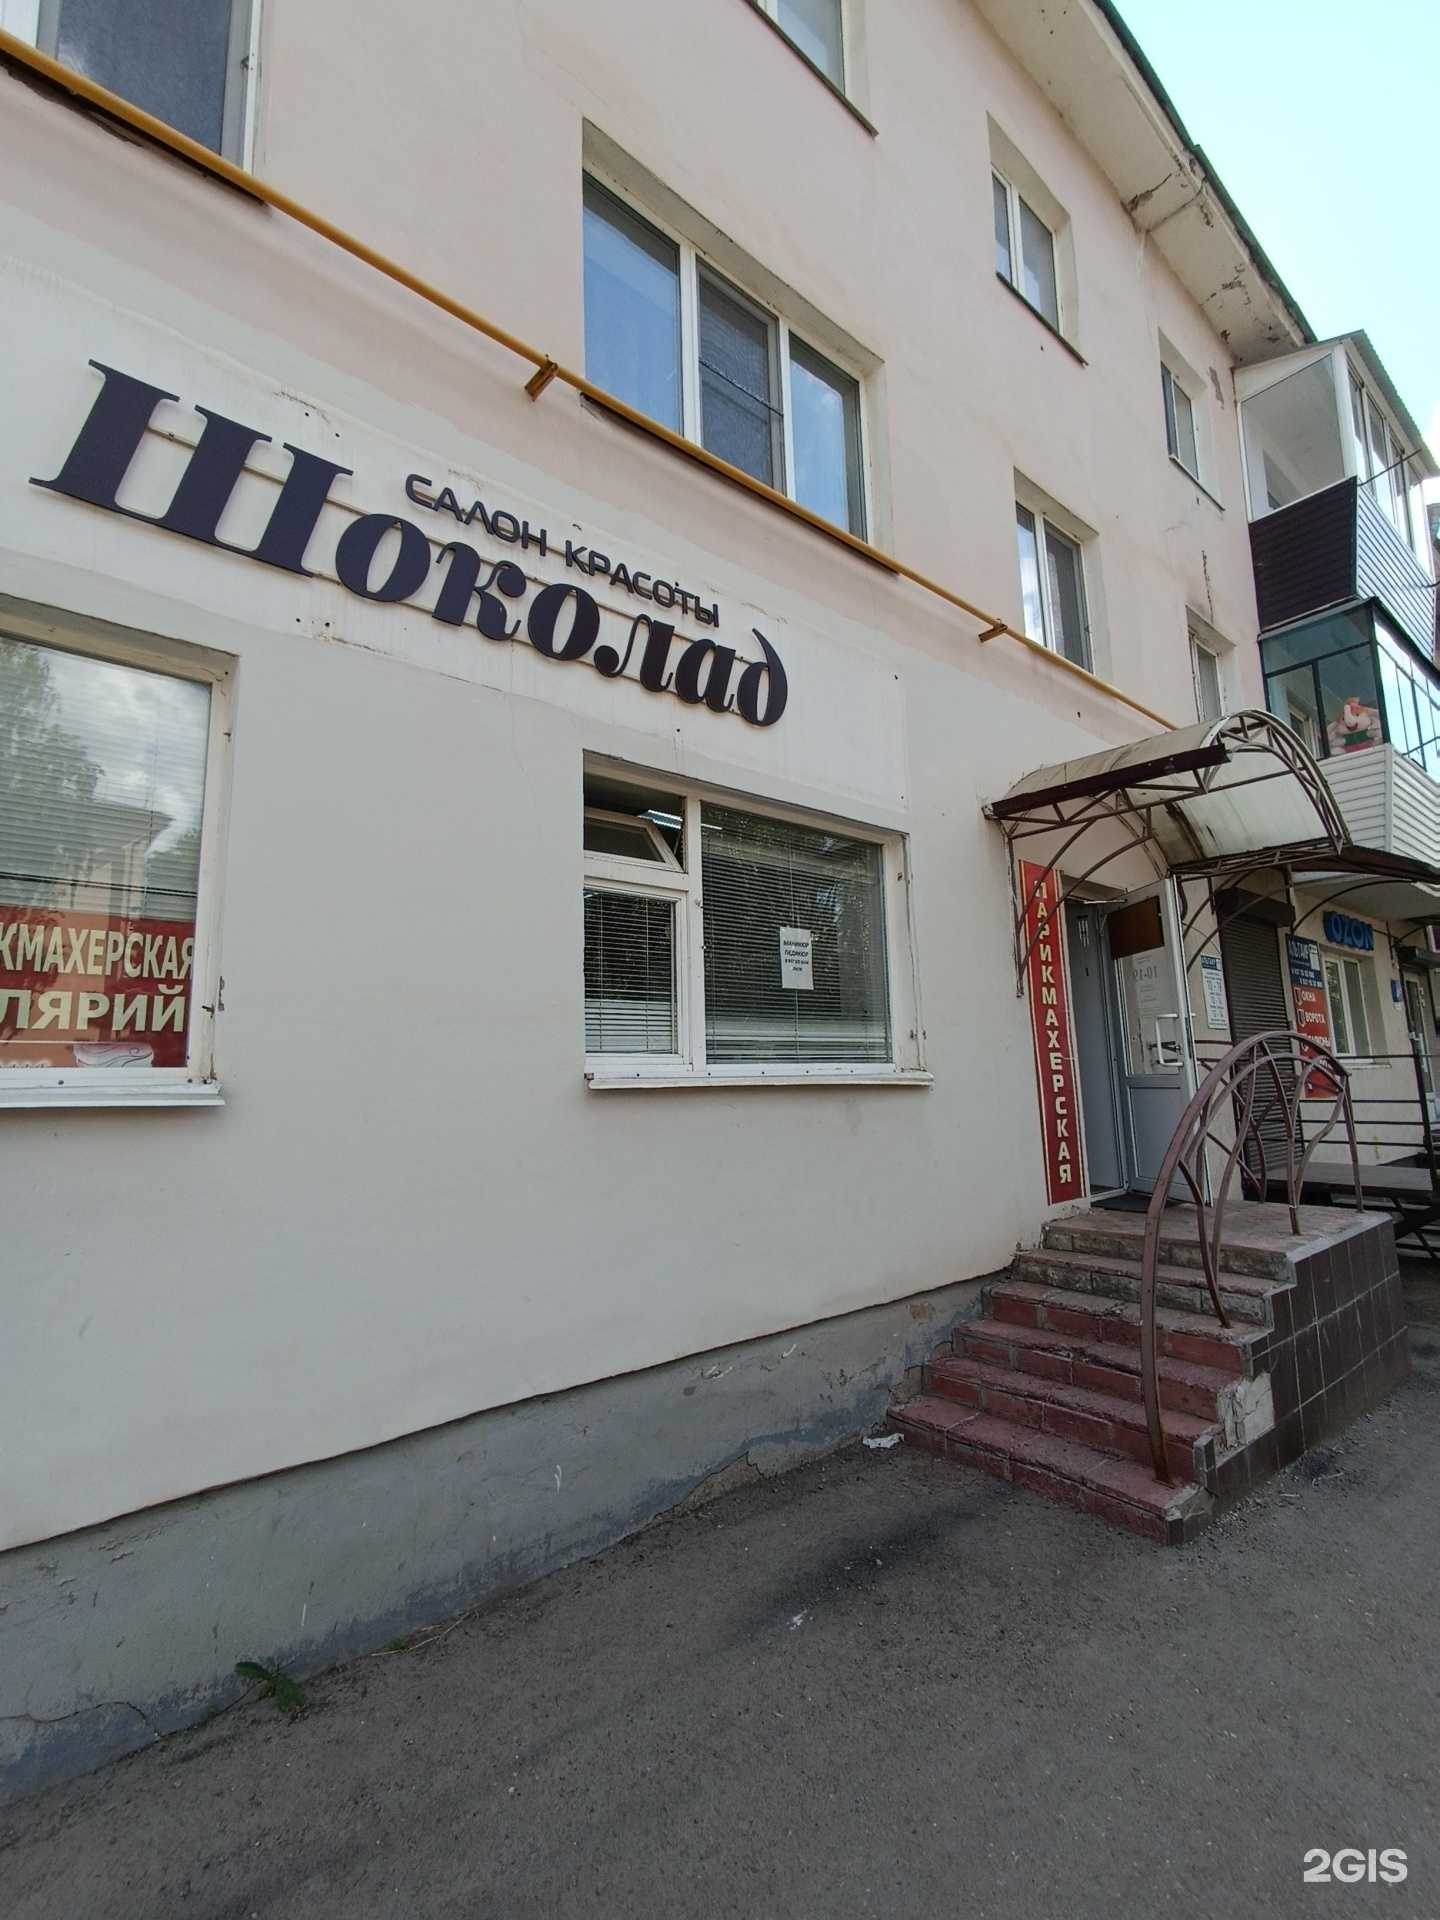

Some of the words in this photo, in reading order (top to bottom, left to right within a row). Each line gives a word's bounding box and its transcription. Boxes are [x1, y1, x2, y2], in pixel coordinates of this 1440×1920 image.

[28, 359, 788, 727] Шоколад
[405, 474, 547, 557] САЛОН
[565, 540, 719, 628] КРАСОТЫ
[1330, 914, 1374, 951] OZON
